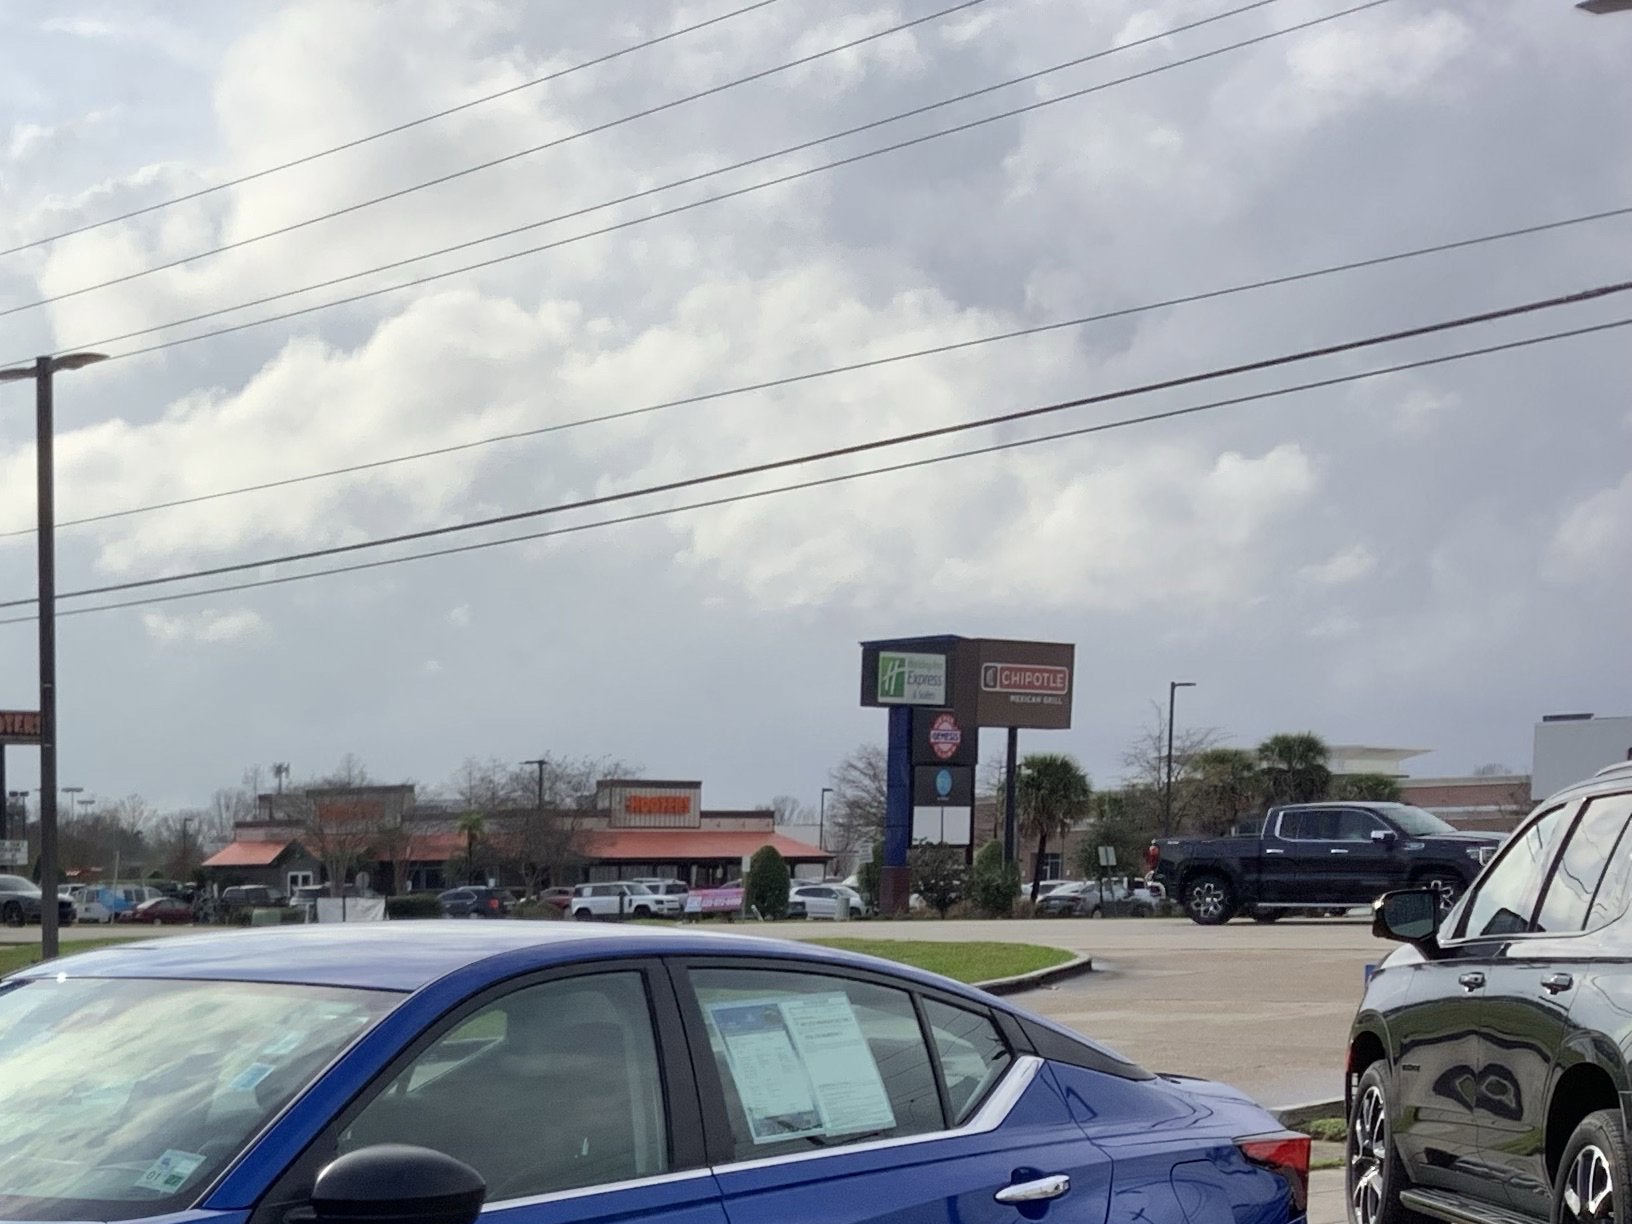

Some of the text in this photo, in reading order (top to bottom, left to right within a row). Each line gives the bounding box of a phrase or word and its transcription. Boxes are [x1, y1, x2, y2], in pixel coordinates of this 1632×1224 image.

[906, 670, 942, 687] Express
[1001, 671, 1065, 688] CHIPOTLE
[1009, 694, 1063, 705] MEXICAN GRILL
[932, 731, 958, 740] GENESIS
[630, 796, 690, 813] HOOTERS
